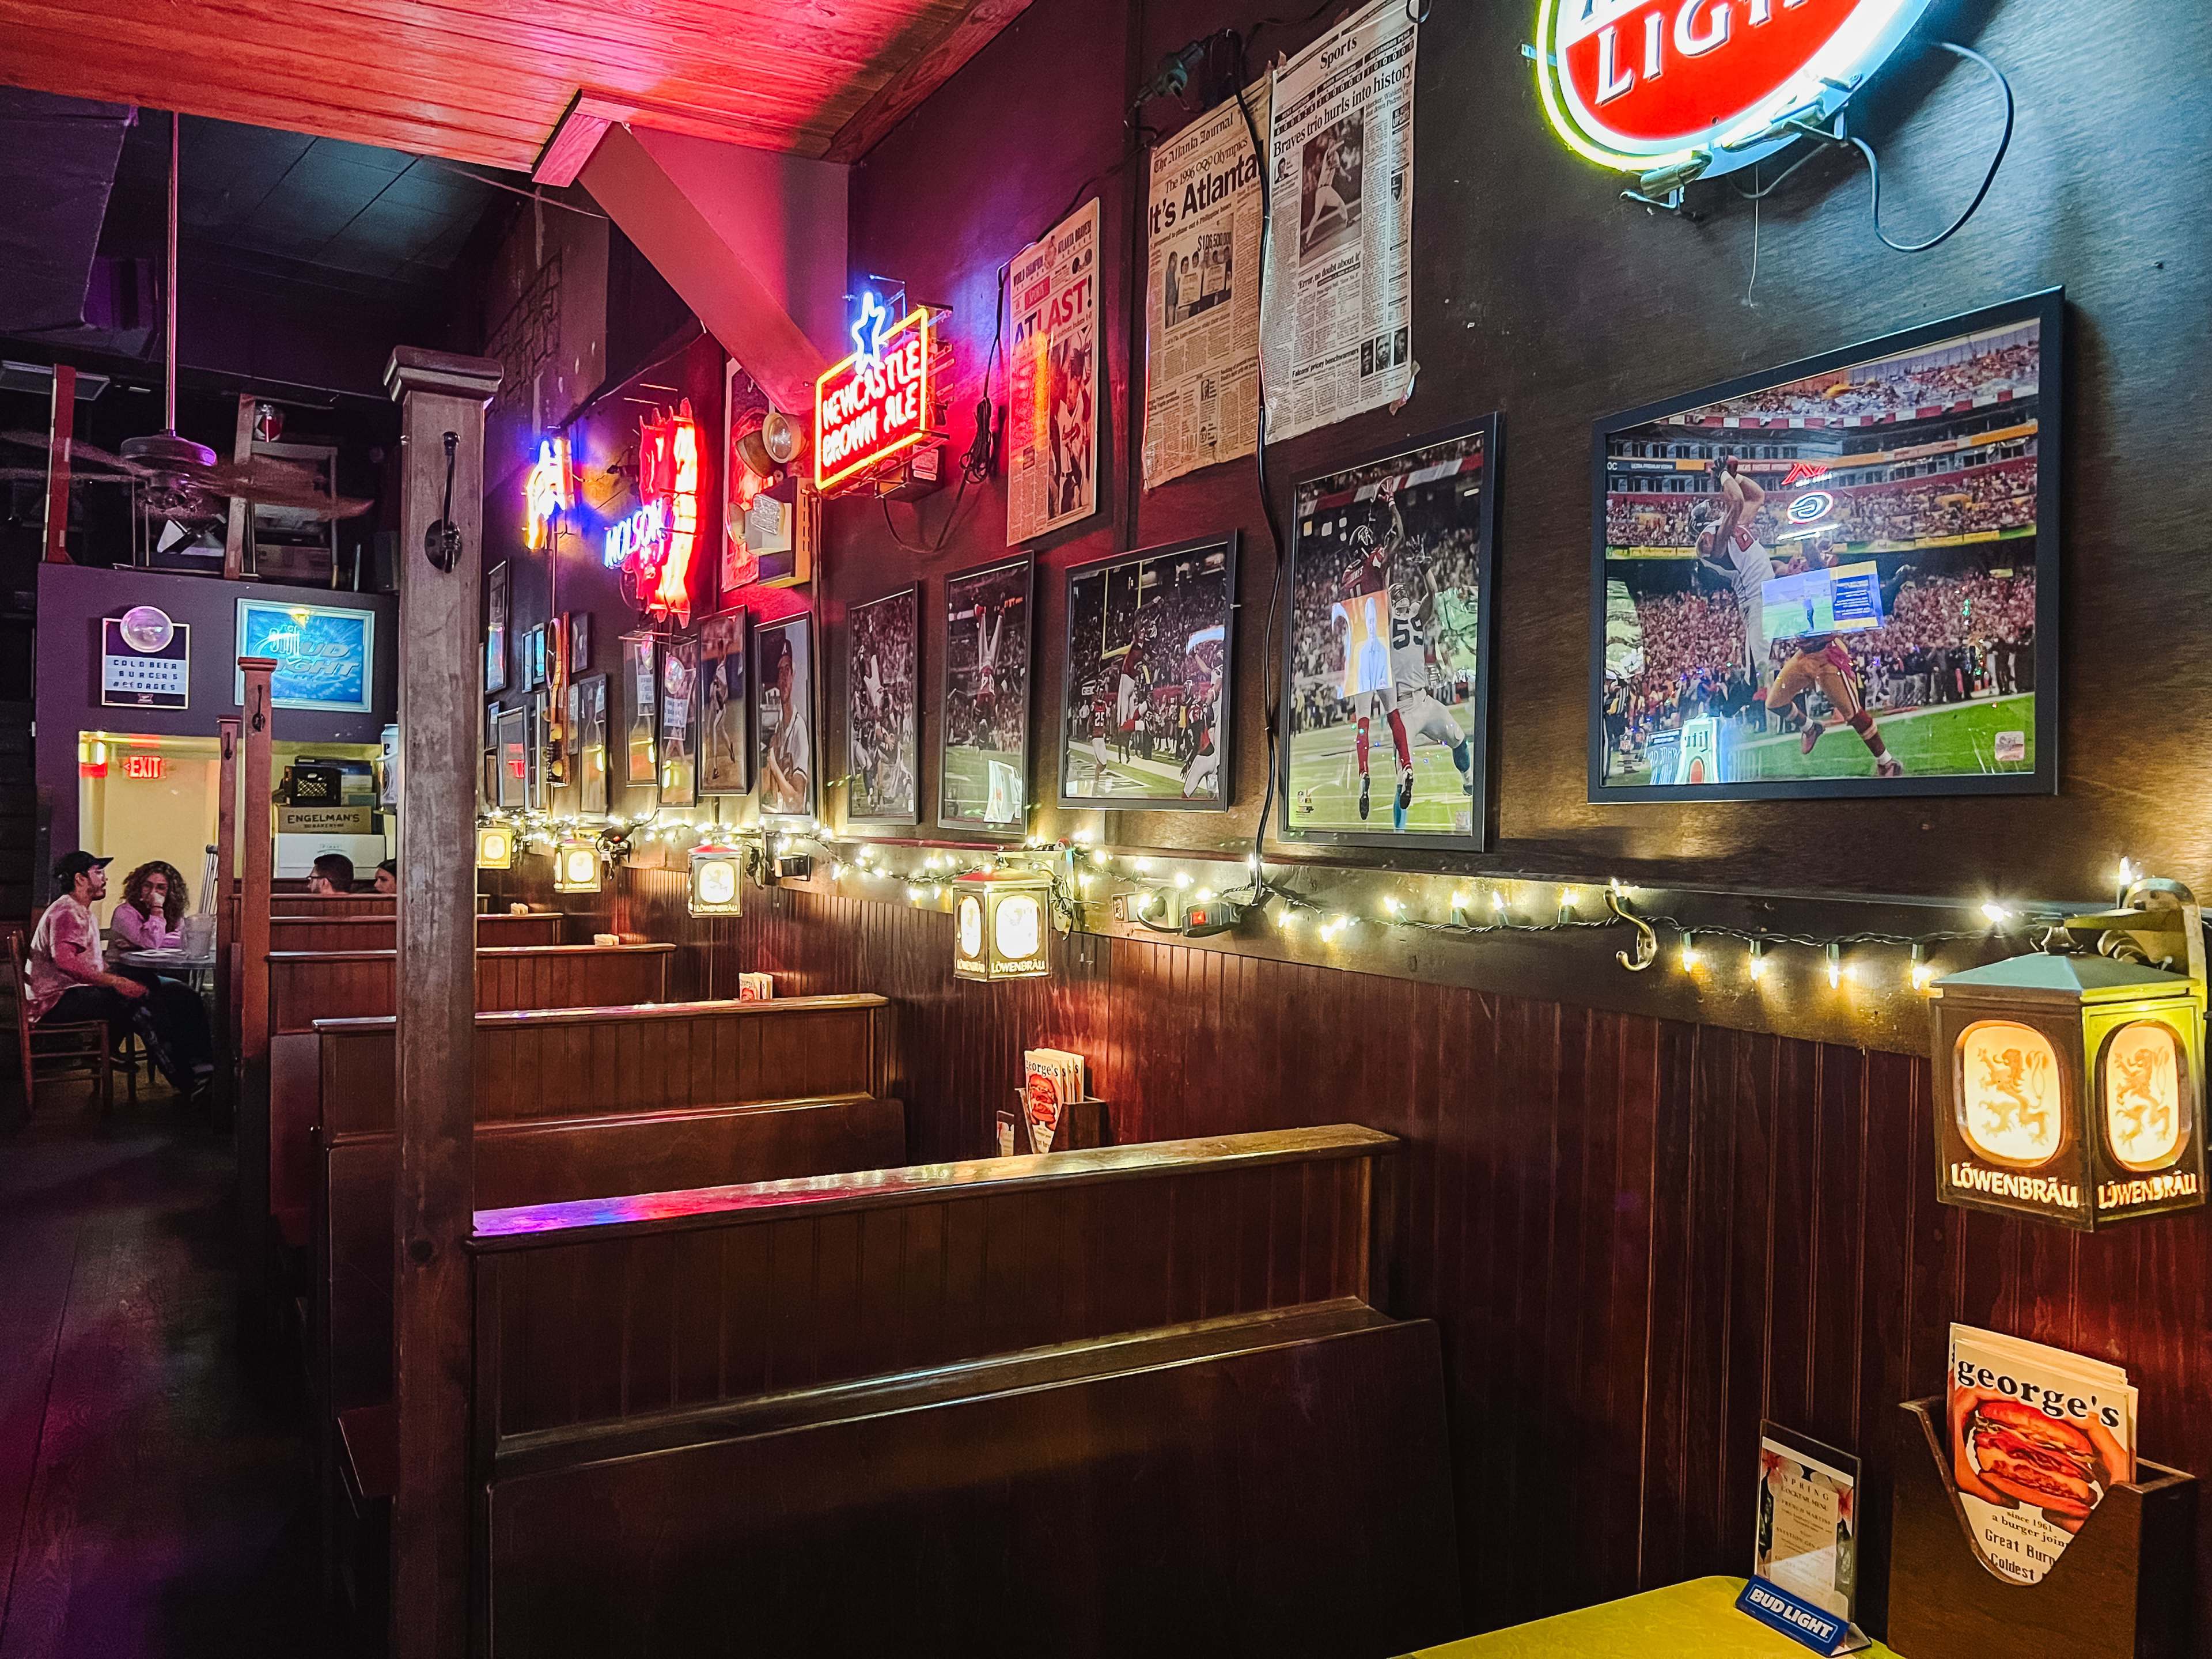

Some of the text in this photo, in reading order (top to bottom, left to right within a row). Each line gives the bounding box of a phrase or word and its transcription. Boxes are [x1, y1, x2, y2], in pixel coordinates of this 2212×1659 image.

[1319, 36, 1357, 70] Sports
[1274, 60, 1413, 158] Braves trio hurls into history
[1199, 113, 1233, 145] Journal
[1165, 137, 1248, 194] The 1996 Olympics
[1149, 198, 1176, 237] It's
[1321, 263, 1336, 277] doubt
[1338, 256, 1354, 269] about
[1013, 312, 1037, 355] AT
[1037, 274, 1092, 335] LAST!
[1310, 359, 1324, 372] pricey
[823, 340, 922, 430] NEWCASTLE
[822, 407, 877, 467] BROWN
[884, 382, 919, 433] ALE
[604, 497, 662, 569] MOLSON
[1392, 618, 1423, 650] 59
[1094, 712, 1105, 726] 25
[129, 756, 161, 778] EXIT
[287, 814, 360, 824] ENGELMAN'S
[991, 959, 1046, 974] LÖWENBRÄU
[1950, 1162, 2079, 1209] LÖWENBRÄU
[2097, 1170, 2198, 1209] LÖWENBRÄU
[1957, 1359, 2120, 1428] george's
[1783, 1475, 1830, 1501] SPRING
[1991, 1514, 1998, 1522] a
[2001, 1516, 2039, 1539] burger
[2006, 1510, 2052, 1533] since 1961
[1985, 1528, 2020, 1553] Great
[1990, 1552, 2035, 1581] Coldest
[1749, 1589, 1834, 1638] BUD LIGHT
